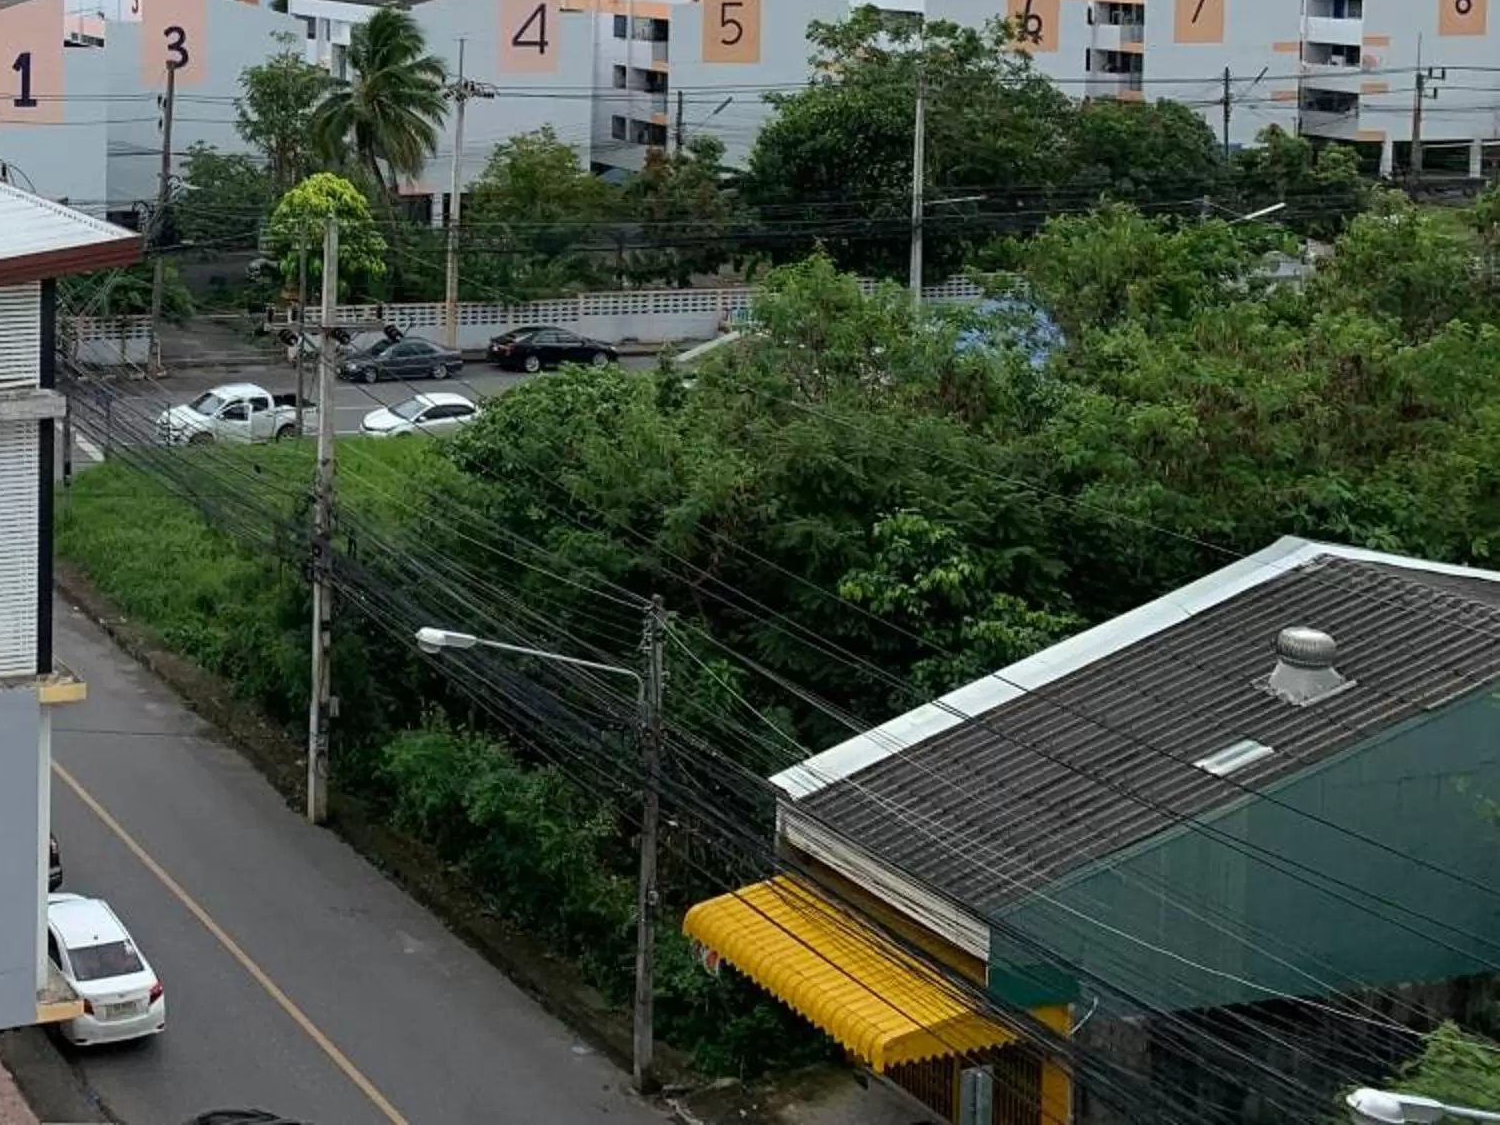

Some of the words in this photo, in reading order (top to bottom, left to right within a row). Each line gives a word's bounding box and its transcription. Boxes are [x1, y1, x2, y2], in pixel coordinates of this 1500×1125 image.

[512, 3, 549, 55] 4
[721, 1, 743, 45] 5
[163, 26, 189, 69] 3
[12, 52, 37, 107] 1
